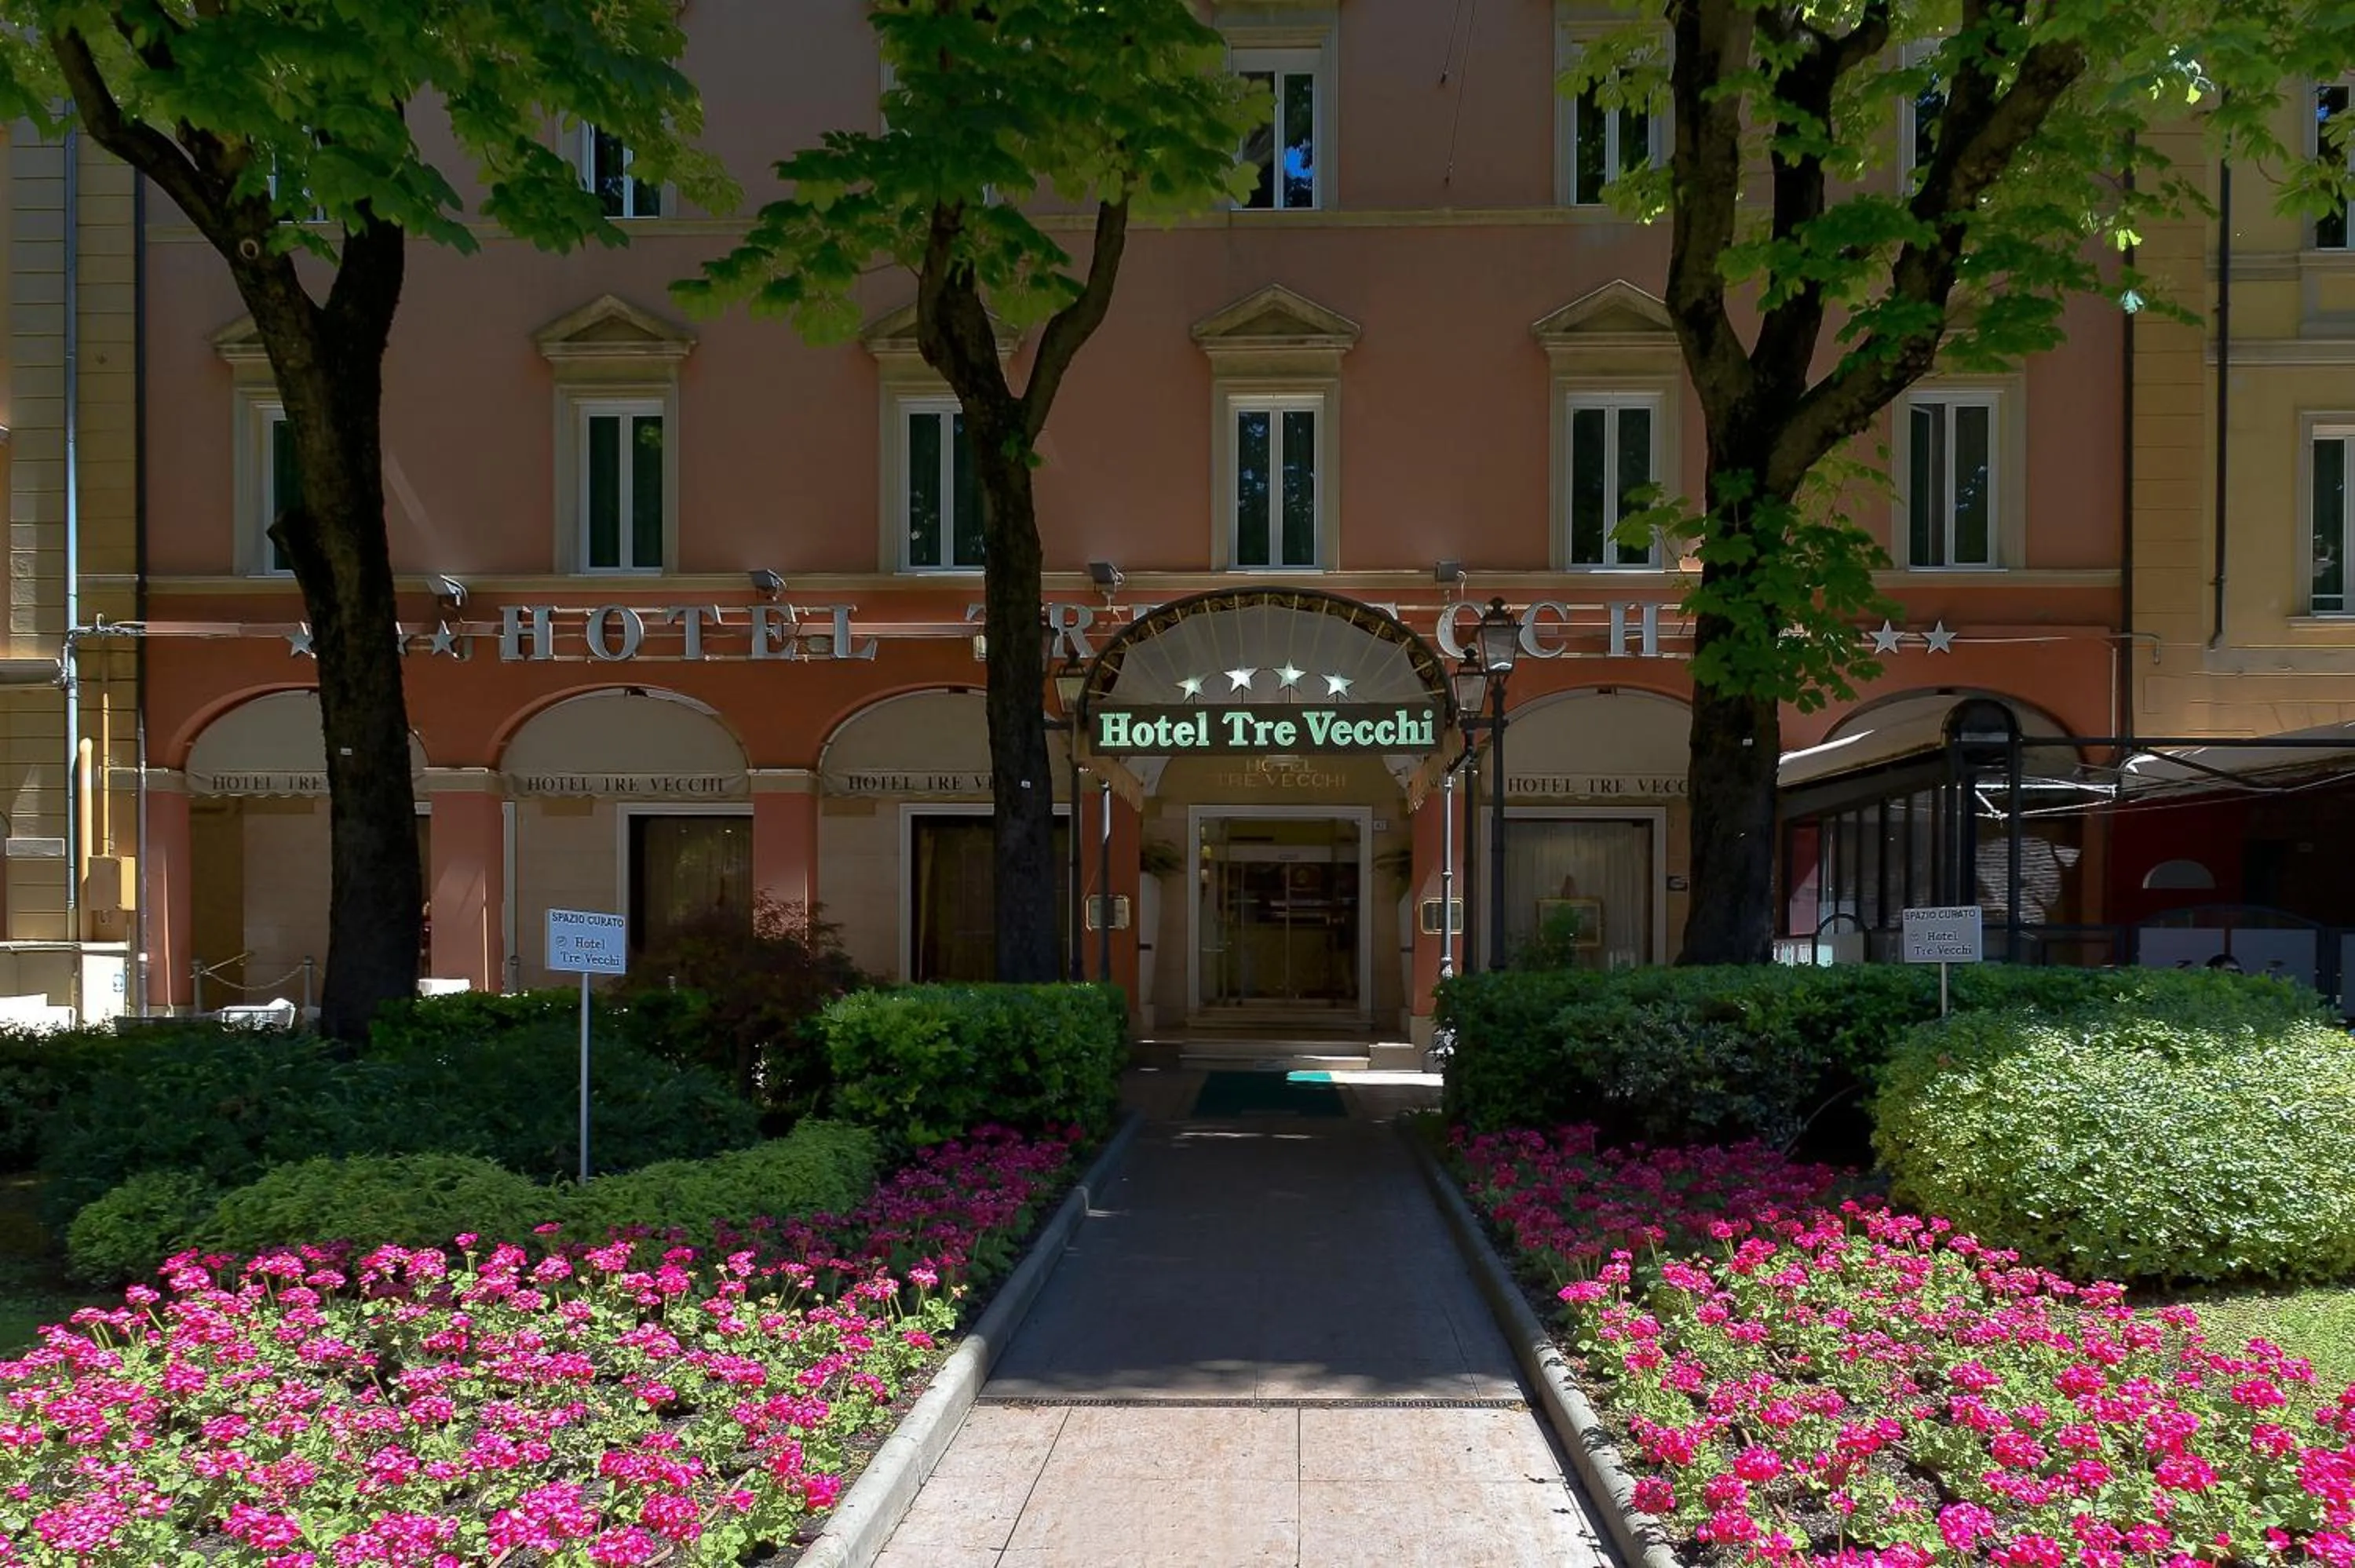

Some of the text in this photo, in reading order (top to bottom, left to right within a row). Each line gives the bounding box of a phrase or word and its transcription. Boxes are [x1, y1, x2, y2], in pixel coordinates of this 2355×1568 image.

[499, 603, 878, 662] HOTEL
[1099, 709, 1435, 747] Hotel Tre Vecchi
[213, 775, 323, 790] HOTEL TRE
[528, 777, 722, 792] HOTEL TRE VECCHI
[849, 775, 914, 790] HOTEL
[928, 776, 962, 790] TRE
[1265, 773, 1345, 788] VECCHI
[1508, 778, 1688, 793] HOTEL TRE VECC
[552, 912, 624, 928] SPAZIO CURATO
[1904, 910, 1975, 920] SPAZIO CURATO
[575, 936, 605, 950] Hotel
[1927, 932, 1958, 941] Hotel
[1914, 944, 1972, 955] Tre Vecchi
[560, 951, 620, 966] Tre Vecchi
